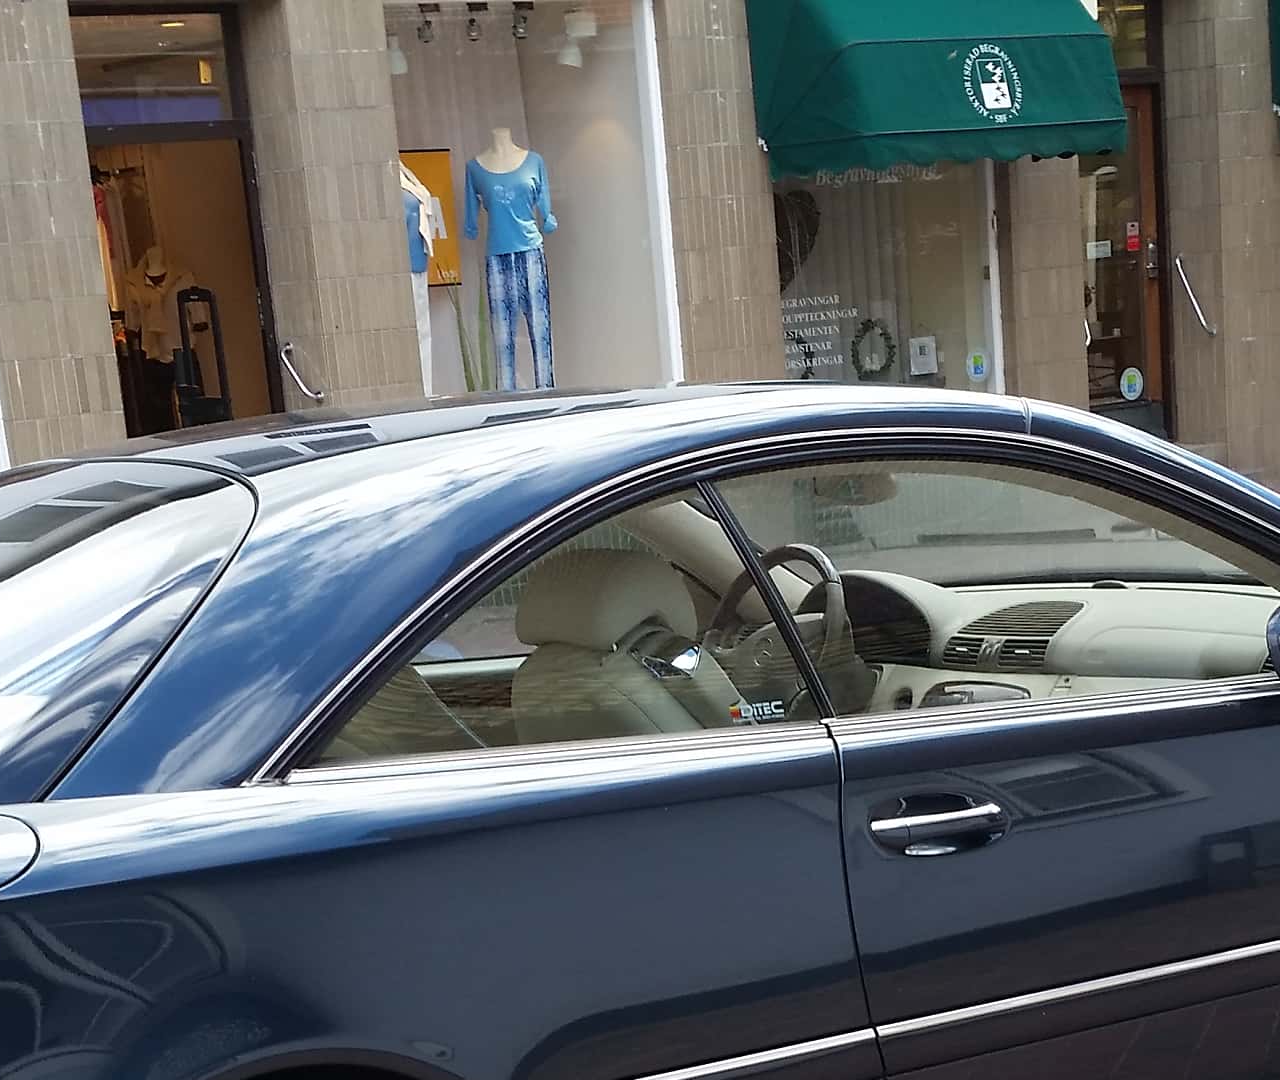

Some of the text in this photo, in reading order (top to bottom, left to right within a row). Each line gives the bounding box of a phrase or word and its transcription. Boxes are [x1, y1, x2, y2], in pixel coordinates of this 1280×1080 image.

[783, 294, 840, 308] EGRAVNINGAR
[783, 307, 858, 324] OUPPTECKNINGAR
[784, 325, 840, 340] ESTAMENTEN
[784, 341, 833, 354] RAVSTENAR
